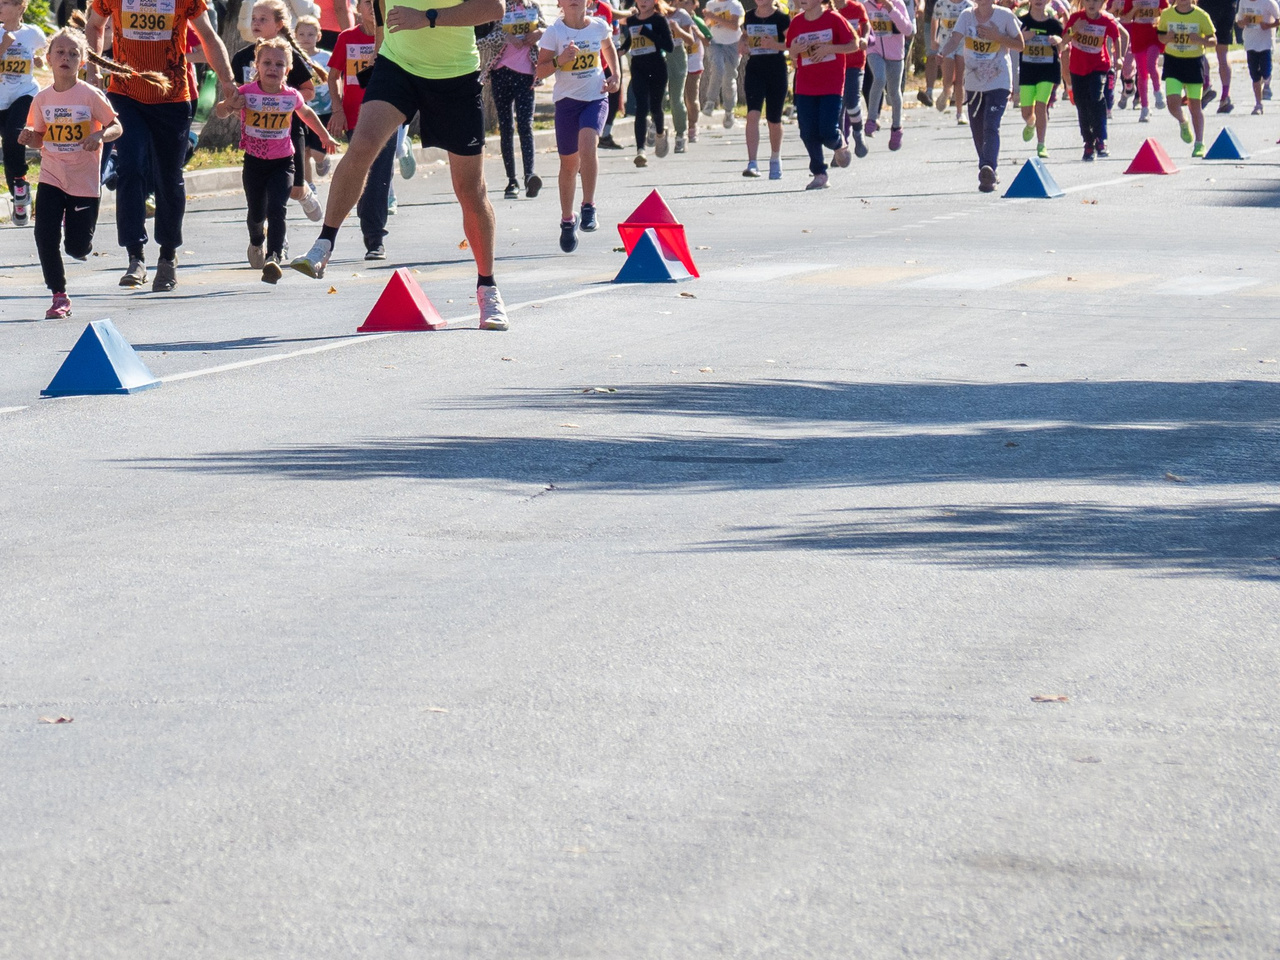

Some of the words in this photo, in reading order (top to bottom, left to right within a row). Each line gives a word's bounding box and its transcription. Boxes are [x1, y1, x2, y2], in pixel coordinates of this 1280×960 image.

[129, 13, 166, 30] 2396
[1076, 33, 1099, 46] 2800
[1174, 33, 1190, 44] 557
[972, 41, 992, 53] 887
[0, 60, 27, 73] 1522
[571, 54, 594, 70] 232
[252, 112, 287, 129] 2177
[48, 124, 83, 141] 1733
